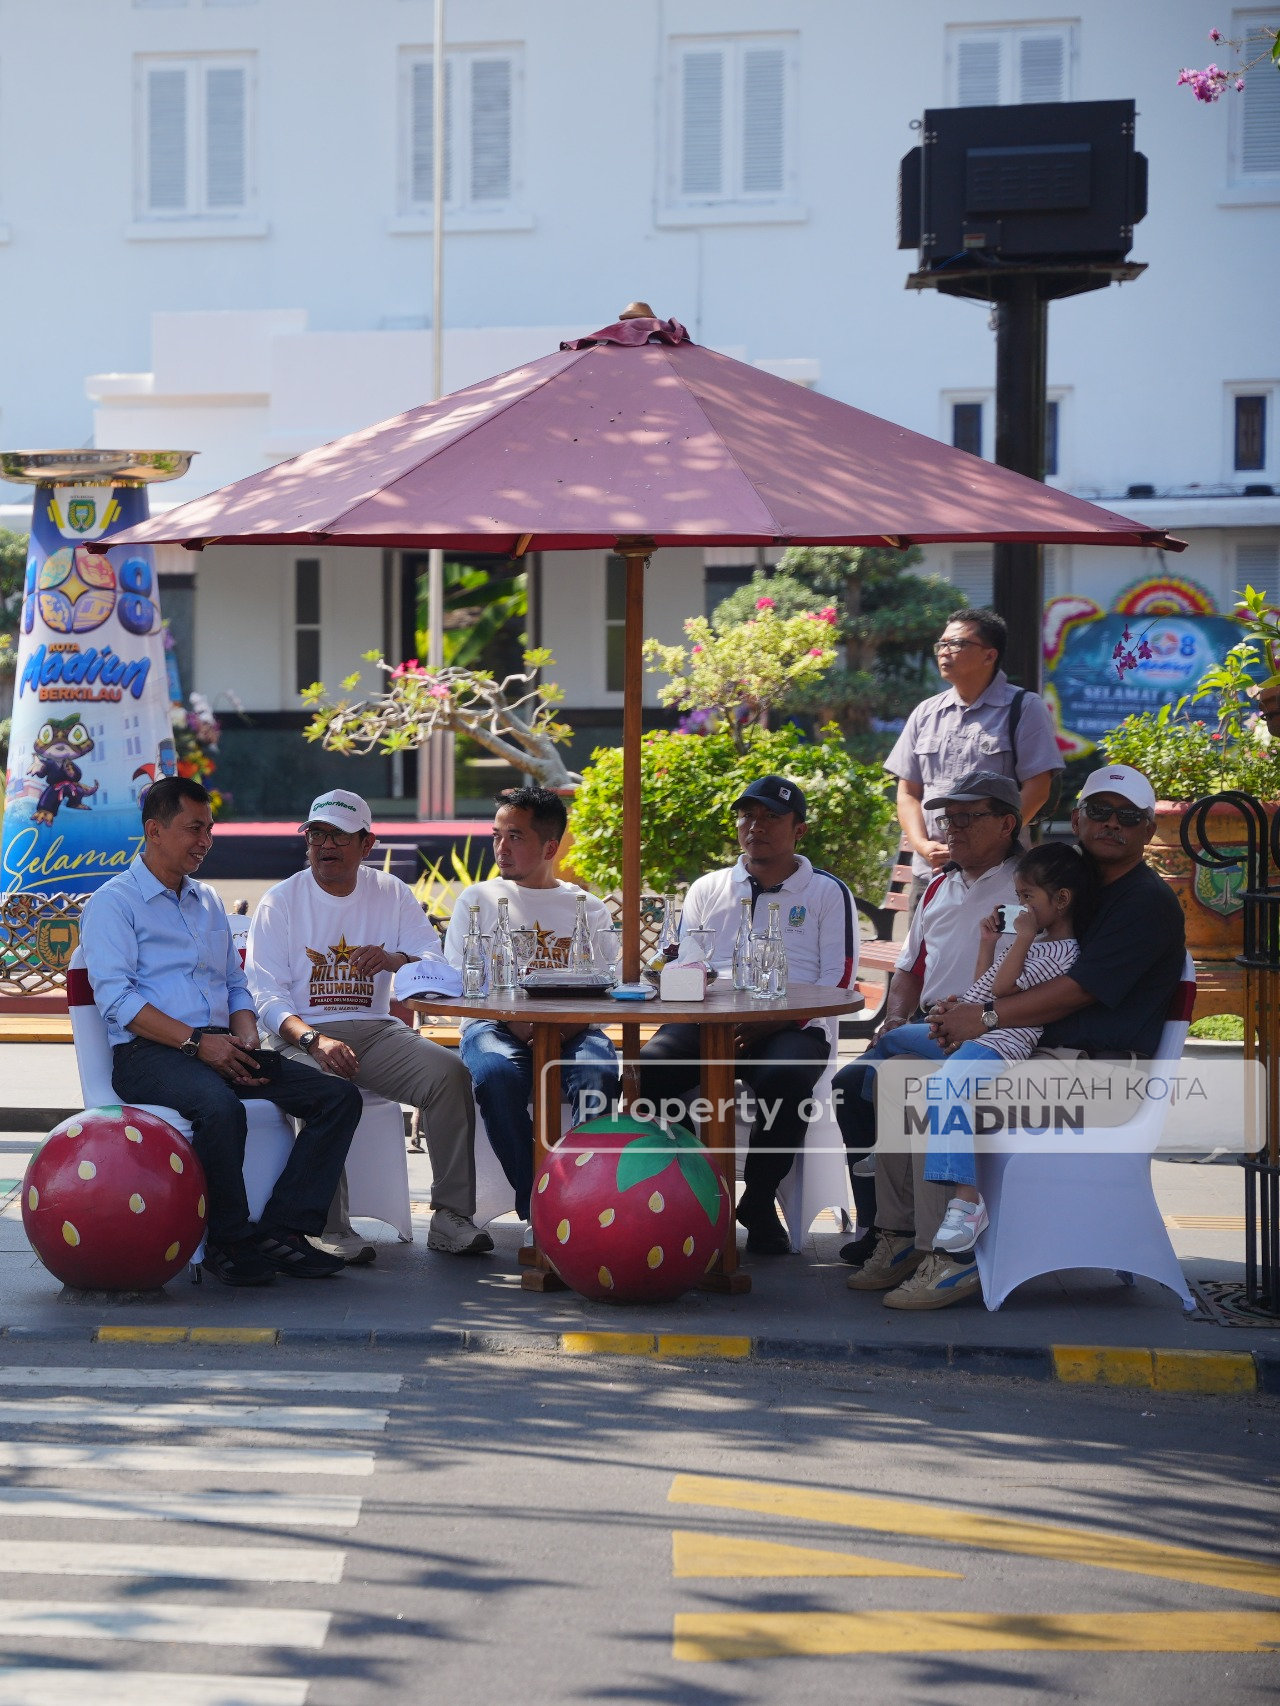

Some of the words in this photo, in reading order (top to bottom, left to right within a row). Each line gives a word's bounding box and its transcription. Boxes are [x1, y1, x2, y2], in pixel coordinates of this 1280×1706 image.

[48, 642, 81, 654] KOTA
[19, 643, 152, 700] Madiun
[38, 686, 123, 703] BERKILAU
[312, 801, 357, 812] TaylorMade
[3, 827, 146, 893] Selamat
[309, 983, 374, 996] DRUMBAND
